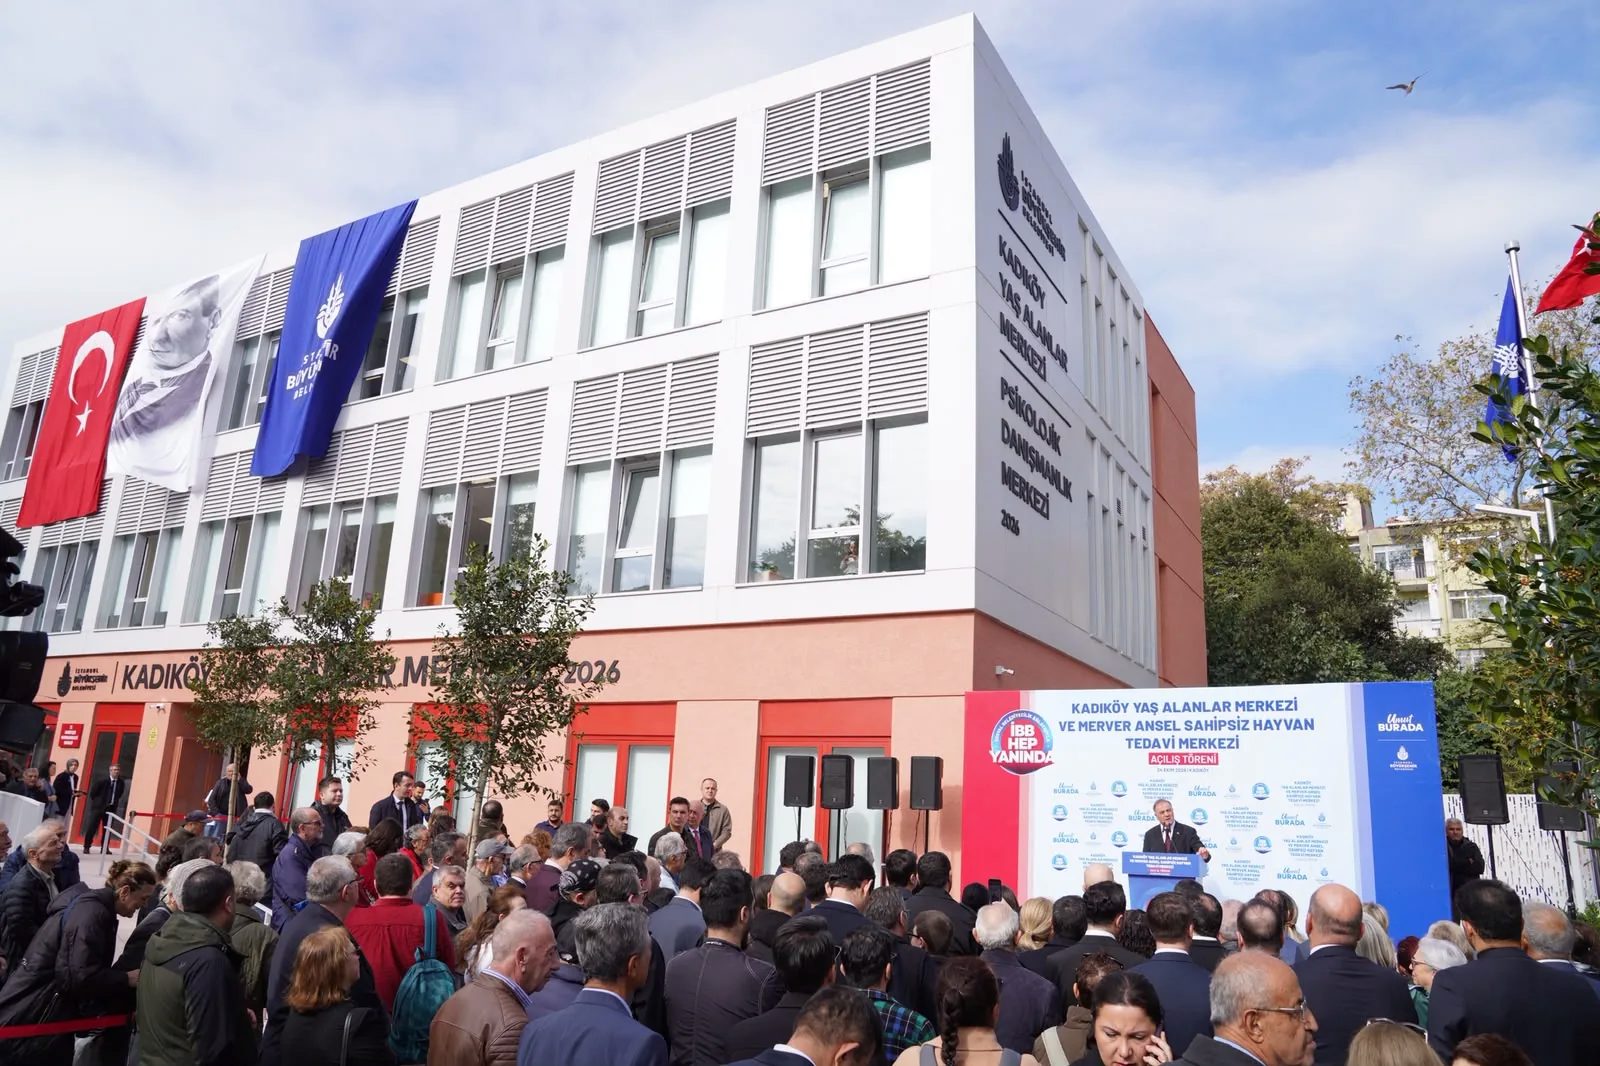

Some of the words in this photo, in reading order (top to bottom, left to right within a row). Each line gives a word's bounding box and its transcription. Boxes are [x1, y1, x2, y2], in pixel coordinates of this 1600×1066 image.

[999, 235, 1046, 309] KADIKÖY
[999, 272, 1021, 318] YAŞ
[1023, 304, 1067, 373] ALANLAR
[1000, 311, 1046, 382] MERKEZİ
[1001, 377, 1061, 456] PSİKOLOJİK
[1001, 418, 1072, 502] DANIŞMANLIK
[1001, 461, 1049, 520] MERKEZİ
[1001, 509, 1020, 536] 2026
[564, 660, 621, 684] 2026
[1071, 700, 1129, 714] KADIKÖY
[1133, 701, 1159, 715] YAŞ
[1162, 700, 1232, 713] ALANLAR
[1235, 697, 1298, 712] MERKEZİ
[1058, 720, 1075, 732] VE
[1078, 720, 1131, 732] MERVER
[1134, 719, 1181, 732] ANSEL
[1184, 716, 1250, 731] SAHİPSİZ
[1253, 718, 1315, 731] HAYVAN
[1377, 723, 1424, 731] BURADA
[1387, 713, 1414, 723] Umut
[1010, 721, 1035, 737] İBB
[1007, 737, 1038, 750] HEP
[1126, 735, 1175, 749] TEDAVİ
[1178, 735, 1240, 749] MERKEZİ
[989, 750, 1055, 763] YANINDA
[1150, 754, 1181, 765] AÇILIŞ
[1182, 753, 1217, 764] TÖRENİ
